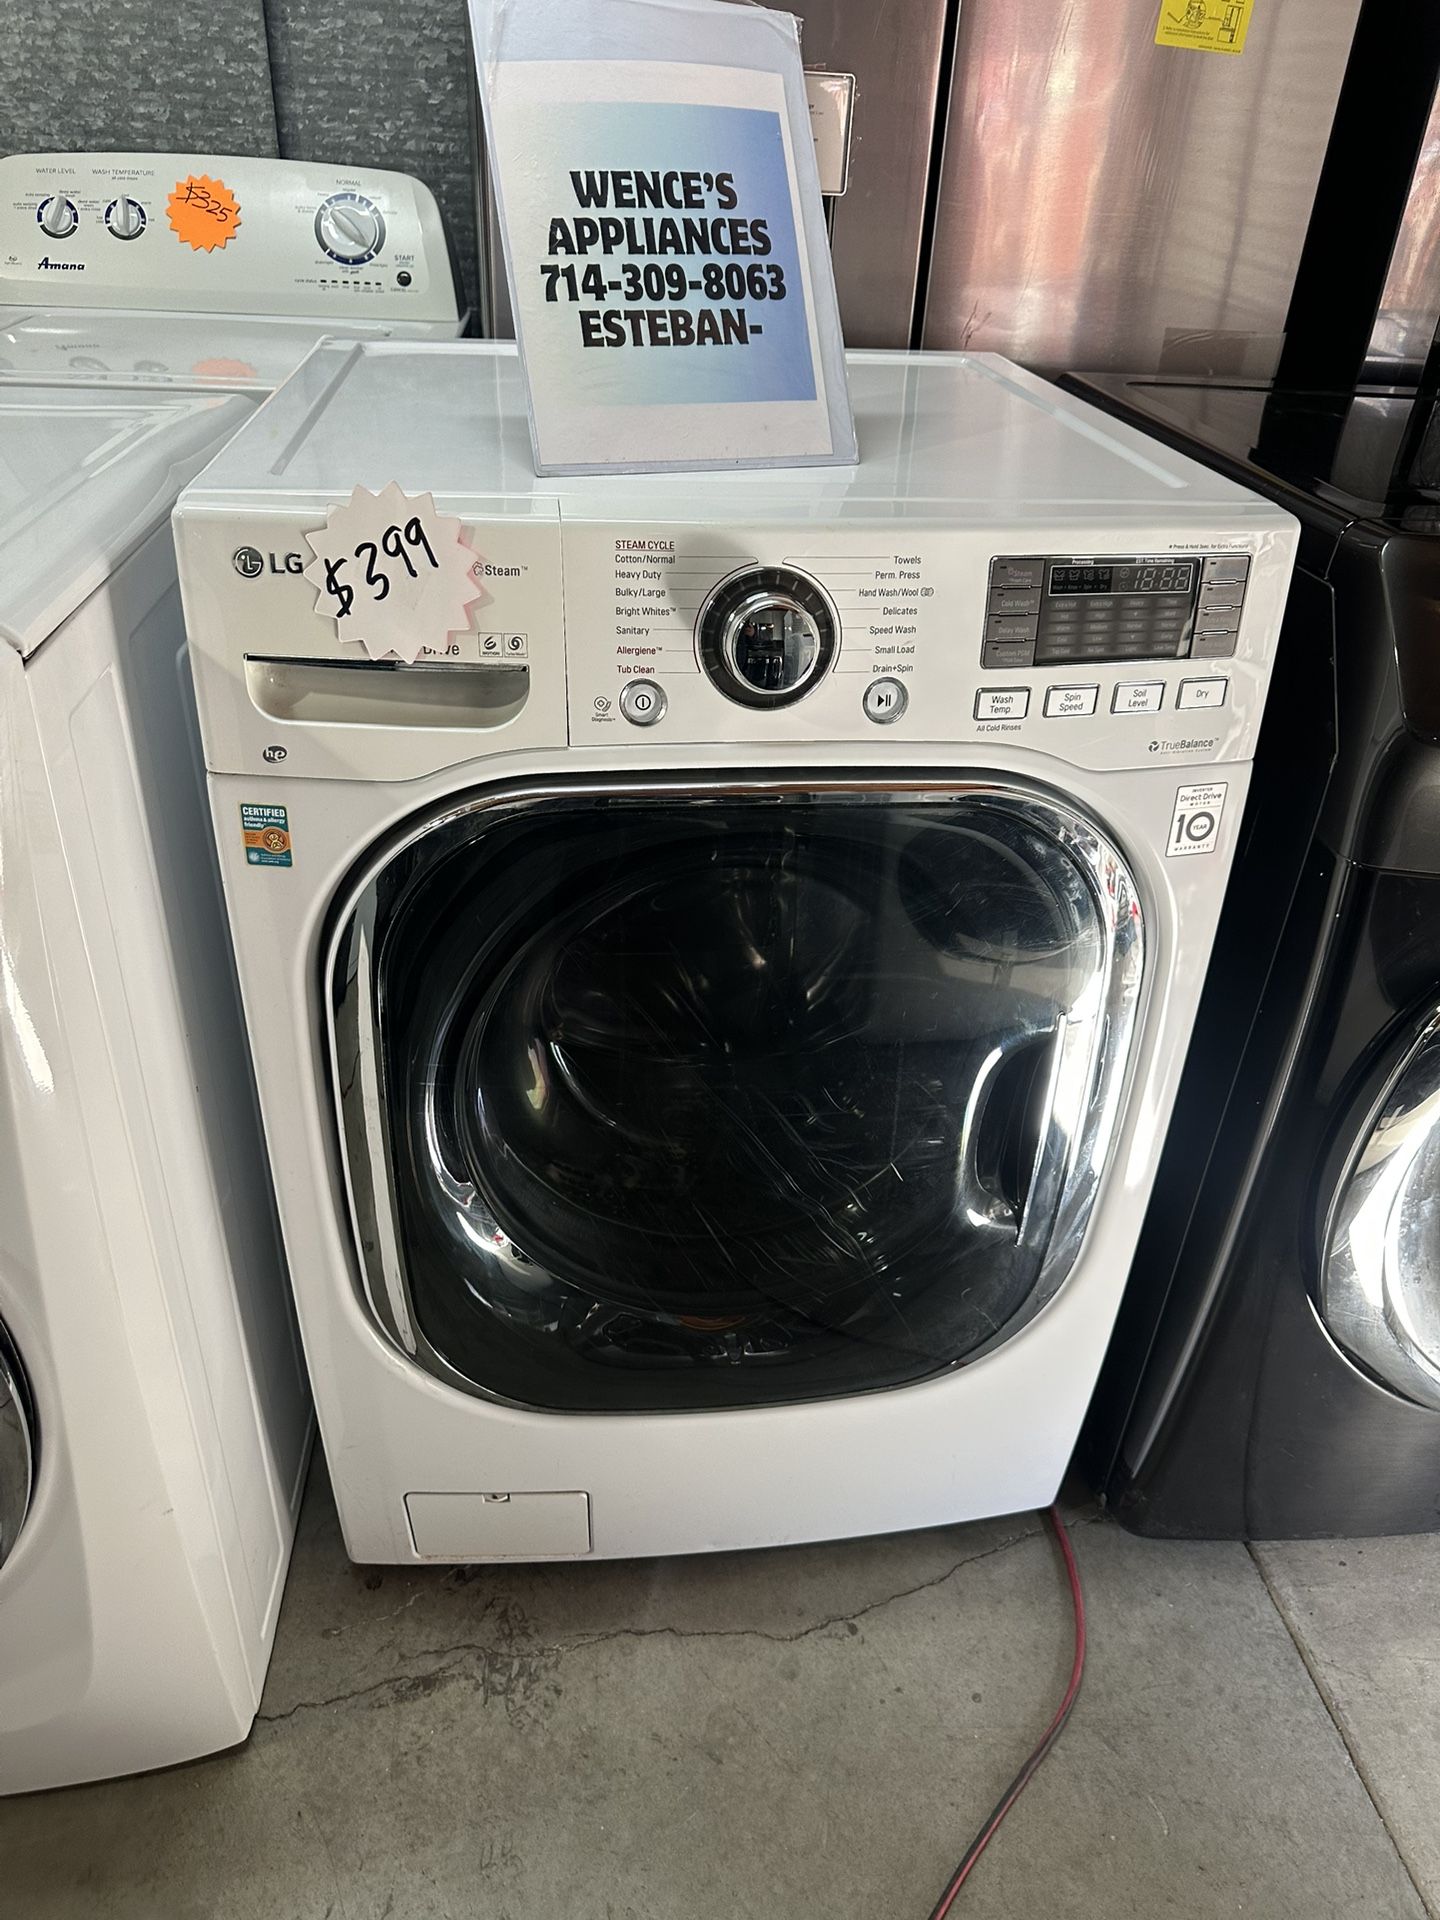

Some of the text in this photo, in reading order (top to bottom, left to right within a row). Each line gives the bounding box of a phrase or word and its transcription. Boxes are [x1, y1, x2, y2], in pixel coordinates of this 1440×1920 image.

[112, 169, 154, 177] TEMPERATURE
[569, 170, 738, 210] WENCE'S
[176, 182, 232, 222] $325
[548, 217, 772, 256] APPLIANCES
[38, 257, 85, 270] Amana
[540, 263, 787, 302] 714-309-8063
[579, 308, 763, 347] ESTEBAN-
[615, 540, 675, 551] STEAM CYCLE
[269, 553, 304, 574] LG
[615, 554, 676, 564] Cotton/Normal
[893, 556, 922, 565] Towels
[324, 516, 439, 618] $399
[615, 570, 662, 580] Heavy Duty
[899, 571, 921, 580] Press
[615, 588, 666, 598] Bulky/Large
[858, 588, 919, 597] Hand Wash/Wool
[615, 607, 641, 617] Bright
[882, 607, 918, 616] Delicates
[616, 626, 650, 636] Sanitary
[869, 626, 917, 635] Speed Wash
[875, 645, 916, 654] Small Load
[617, 665, 656, 674] Tub Clean
[872, 664, 914, 674] Drain+Spin
[1064, 692, 1082, 702] Spin
[1133, 689, 1148, 698] Soil
[1196, 690, 1210, 700] Dry
[991, 695, 1014, 704] Wash
[1128, 699, 1149, 708] Level
[1060, 702, 1085, 712] Speed
[976, 723, 1022, 732] All Cold Rinses
[1180, 792, 1222, 802] Direct Drive
[242, 806, 286, 818] CERTIFIED
[1176, 811, 1215, 844] 10
